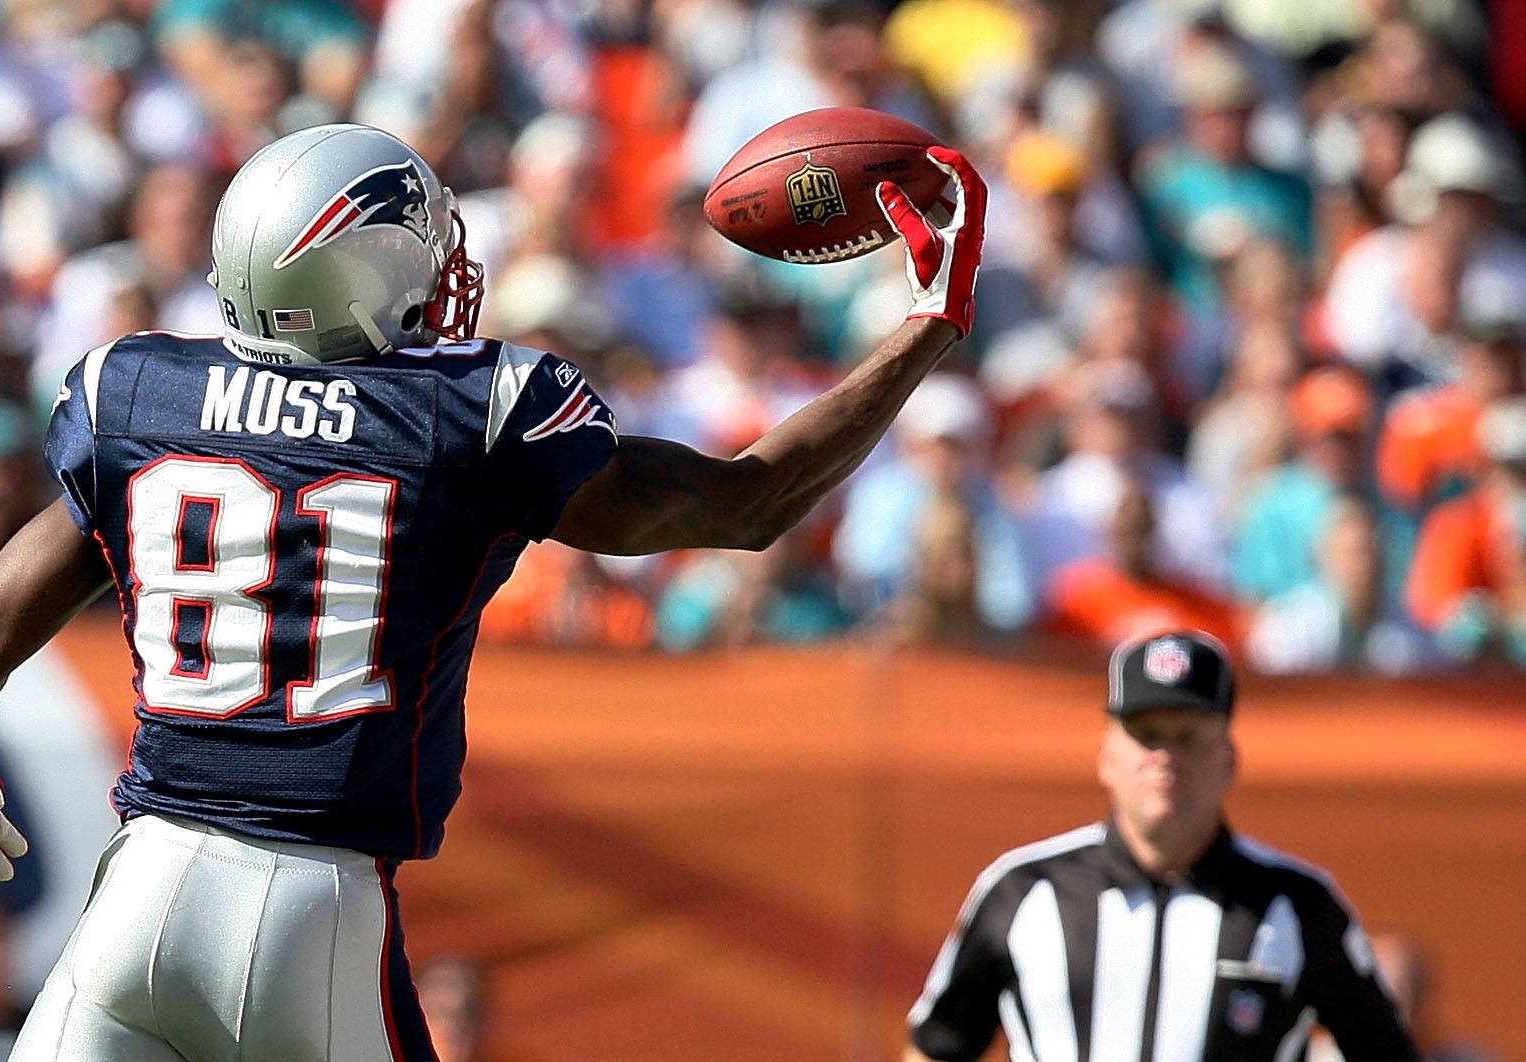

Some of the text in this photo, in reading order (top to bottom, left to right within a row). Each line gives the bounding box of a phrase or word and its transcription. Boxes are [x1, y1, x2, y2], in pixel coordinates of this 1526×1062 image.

[792, 173, 837, 203] NFL
[200, 365, 357, 443] MOSS
[126, 453, 398, 724] 81
